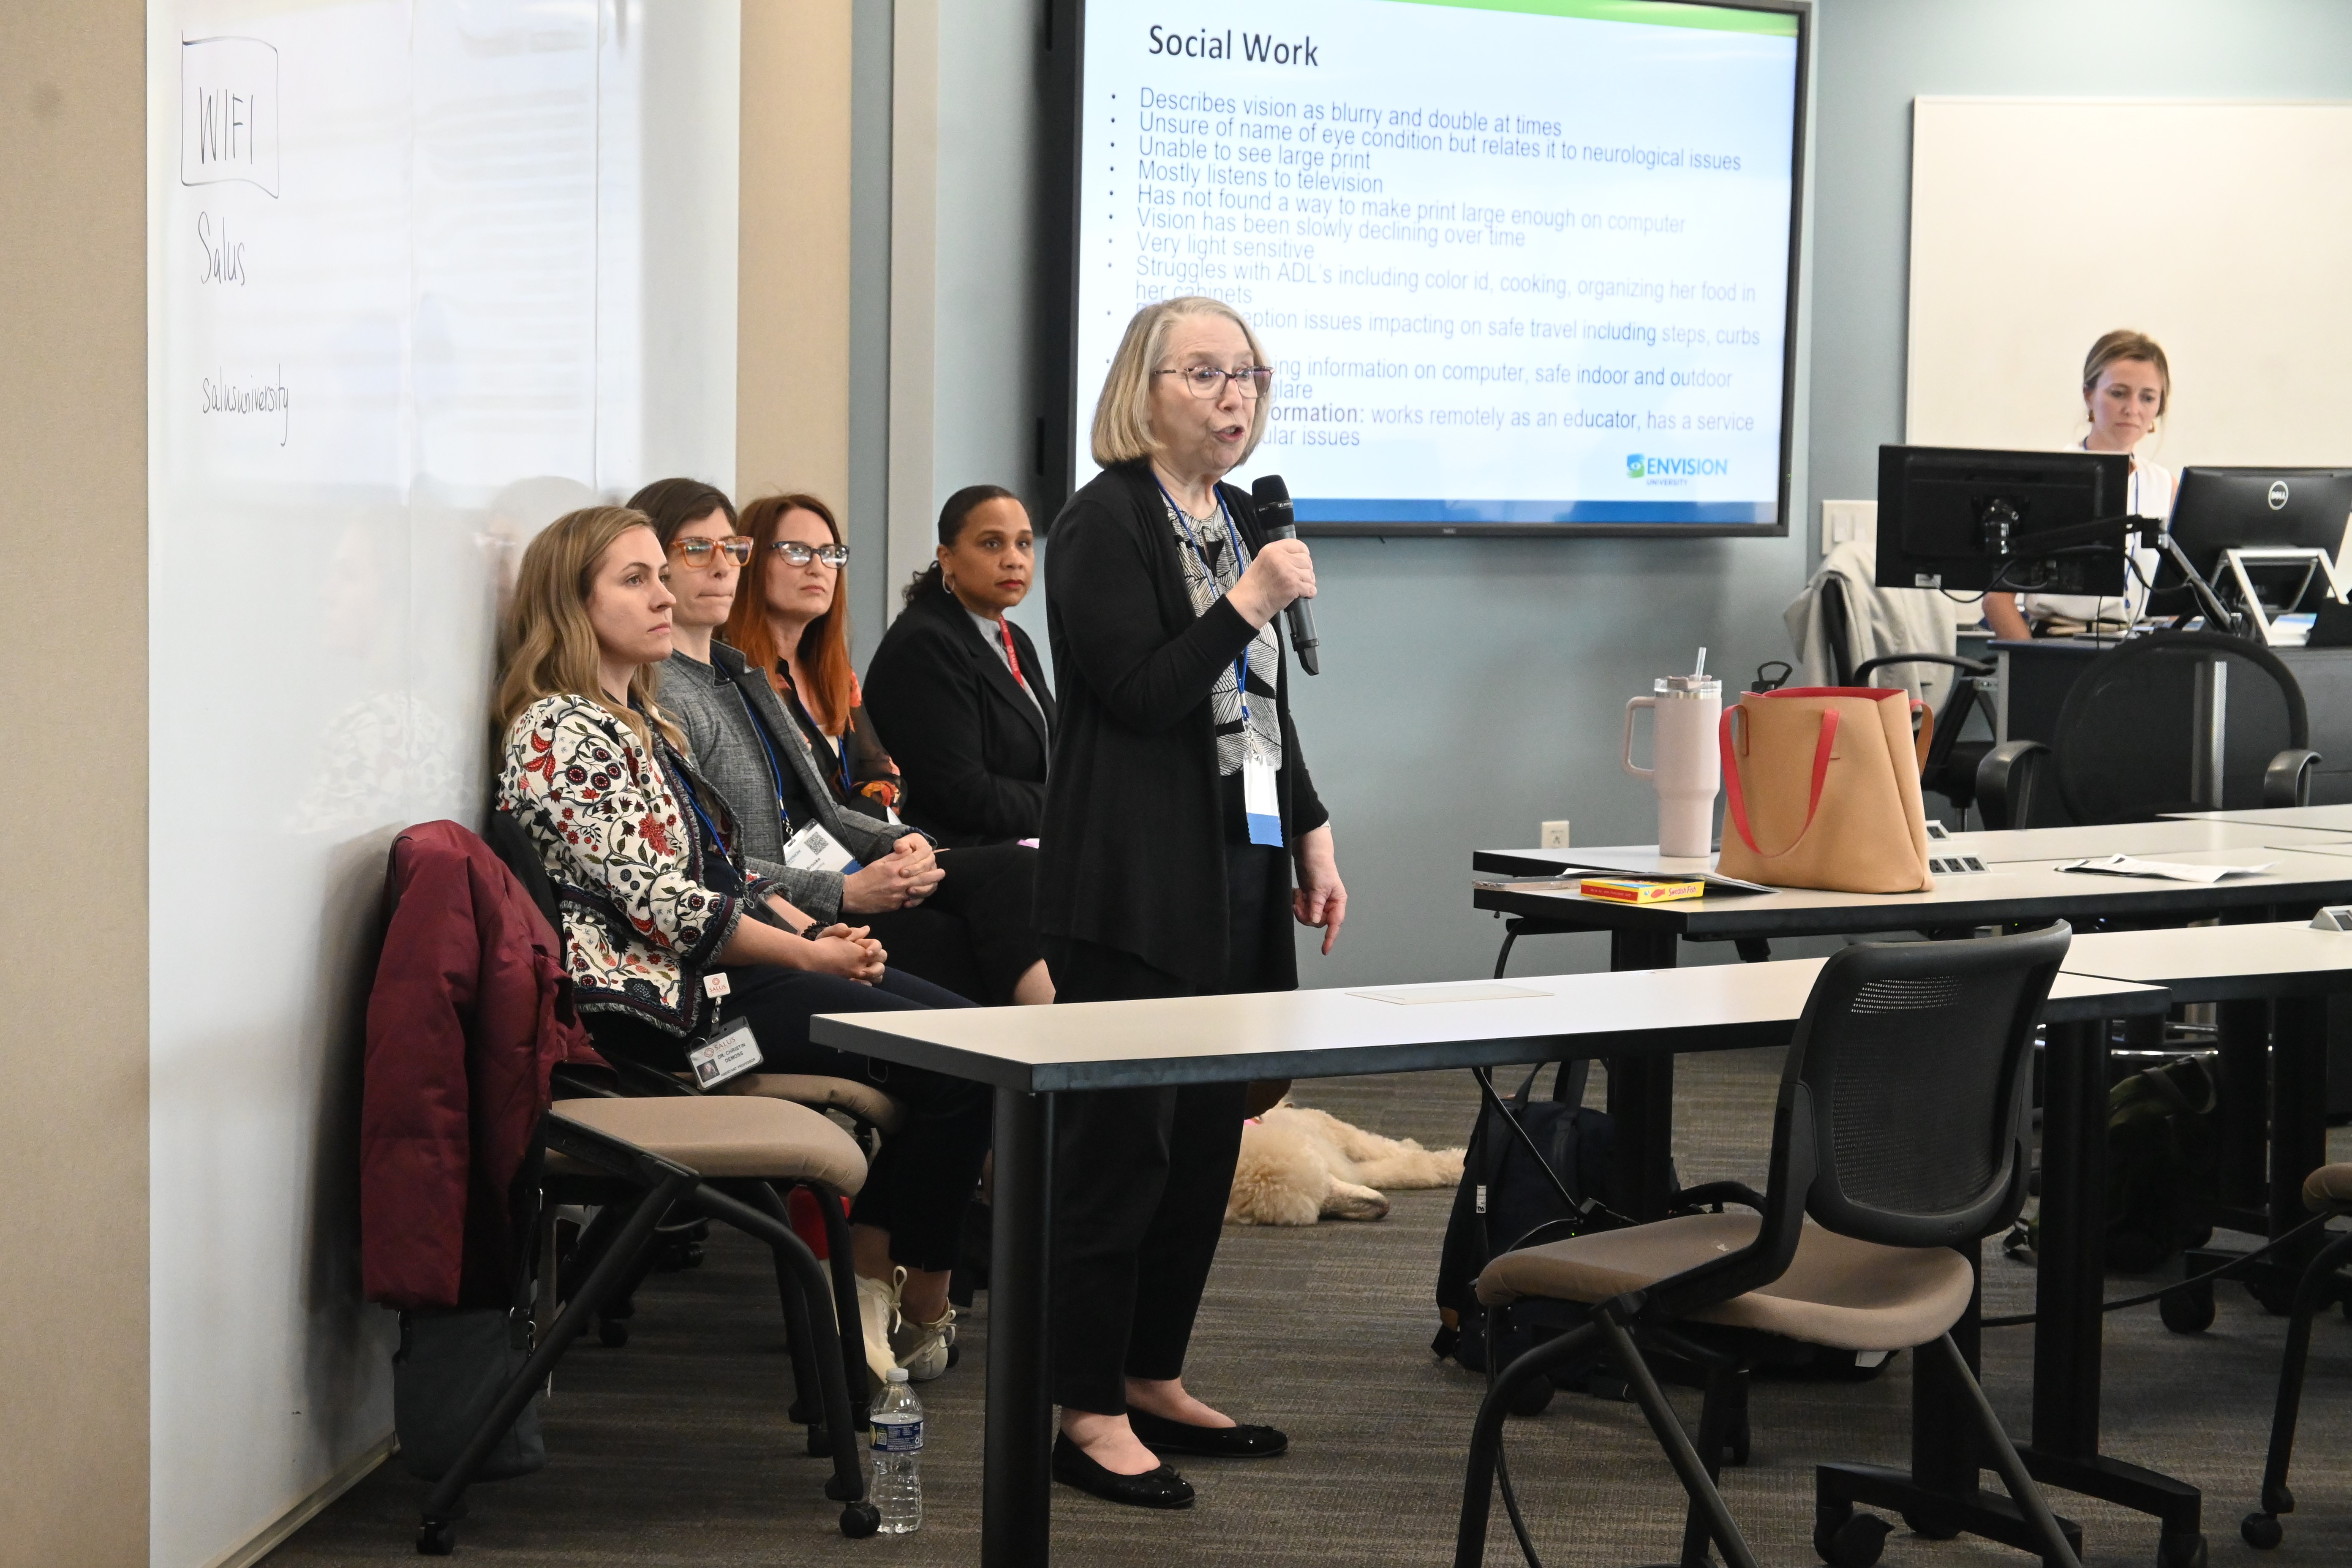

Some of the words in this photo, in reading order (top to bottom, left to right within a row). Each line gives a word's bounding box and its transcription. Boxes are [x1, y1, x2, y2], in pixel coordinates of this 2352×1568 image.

[1149, 25, 1231, 59] Social
[1243, 32, 1318, 66] Work
[199, 87, 253, 164] WIFI
[1141, 87, 1236, 113] Describes
[1244, 95, 1296, 117] vision
[1304, 104, 1324, 119] as
[1332, 101, 1382, 128] blurry
[1389, 108, 1421, 126] and
[1429, 108, 1487, 131] double
[1494, 115, 1509, 132] at
[1517, 115, 1561, 136] times
[1141, 112, 1208, 135] Unsure
[1217, 117, 1233, 136] of
[1241, 123, 1291, 140] name
[1299, 123, 1316, 142] of
[1323, 129, 1354, 149] eye
[1362, 129, 1442, 150] condition
[1450, 133, 1475, 152] but
[1483, 136, 1540, 157] relates
[1547, 139, 1554, 158] it
[1563, 141, 1576, 159] to
[1583, 146, 1683, 170] neurological
[1690, 149, 1741, 170] issues
[1141, 136, 1206, 158] Unable
[1215, 141, 1230, 160] to
[1239, 147, 1271, 162] see
[1279, 144, 1323, 171] large
[1331, 150, 1370, 172] print
[1139, 160, 1200, 188] Mostly
[1209, 163, 1266, 186] listens
[1275, 167, 1290, 187] to
[1298, 171, 1382, 193] television
[1139, 184, 1175, 205] Has
[1184, 189, 1211, 207] not
[1220, 188, 1270, 210] found
[1279, 197, 1288, 211] a
[1296, 198, 1331, 219] way
[1340, 196, 1355, 215] to
[1363, 198, 1410, 218] make
[1418, 201, 1455, 223] print
[1463, 203, 1505, 227] large
[1512, 208, 1575, 231] enough
[1582, 213, 1601, 229] on
[1609, 215, 1685, 235] computer
[1138, 207, 1194, 229] Vision
[1204, 210, 1236, 231] has
[1244, 212, 1288, 234] been
[1297, 217, 1352, 242] slowly
[1359, 220, 1437, 247] declining
[1446, 229, 1483, 244] over
[1490, 226, 1525, 246] time
[198, 211, 245, 286] Salus
[1138, 231, 1180, 258] Very
[1189, 234, 1226, 259] light
[1234, 237, 1314, 259] sensitive
[1136, 279, 1166, 299] her
[1174, 282, 1252, 303] cabinets
[1137, 255, 1226, 283] Struggles
[1234, 260, 1269, 280] with
[1277, 262, 1331, 283] ADL's
[1339, 264, 1418, 292] including
[1426, 270, 1468, 289] color
[1475, 271, 1493, 294] id,
[1501, 273, 1571, 299] cooking,
[1578, 278, 1663, 303] organizing
[1670, 280, 1696, 299] her
[1702, 281, 1736, 301] food
[1743, 283, 1755, 302] in
[1242, 308, 1297, 331] eption
[1305, 309, 1361, 330] issues
[1369, 312, 1454, 339] impacting
[1461, 320, 1481, 335] on
[1489, 317, 1524, 336] safe
[1531, 318, 1576, 338] travel
[1583, 320, 1656, 346] including
[1663, 325, 1710, 347] steps,
[1717, 327, 1760, 345] curbs
[1275, 355, 1300, 380] ing
[1309, 356, 1407, 378] information
[1415, 364, 1435, 379] on
[1443, 363, 1528, 386] computer,
[1536, 364, 1571, 382] safe
[1577, 365, 1629, 384] indoor
[1635, 367, 1664, 385] and
[1671, 369, 1733, 387] outdoor
[1271, 403, 1363, 422] ormation:
[1372, 405, 1423, 424] works
[1430, 407, 1505, 430] remotely
[1511, 412, 1530, 426] as
[1537, 412, 1557, 426] an
[1564, 409, 1640, 431] educator,
[1647, 411, 1676, 429] has
[1682, 415, 1690, 430] a
[1698, 412, 1754, 430] service
[1263, 425, 1296, 444] ular
[1303, 425, 1359, 446] issues
[1647, 458, 1728, 476] ENVISION
[786, 849, 801, 863] NVISION
[806, 858, 821, 870] Brooke
[1669, 887, 1686, 896] Swedish
[714, 1036, 736, 1051] SALUS
